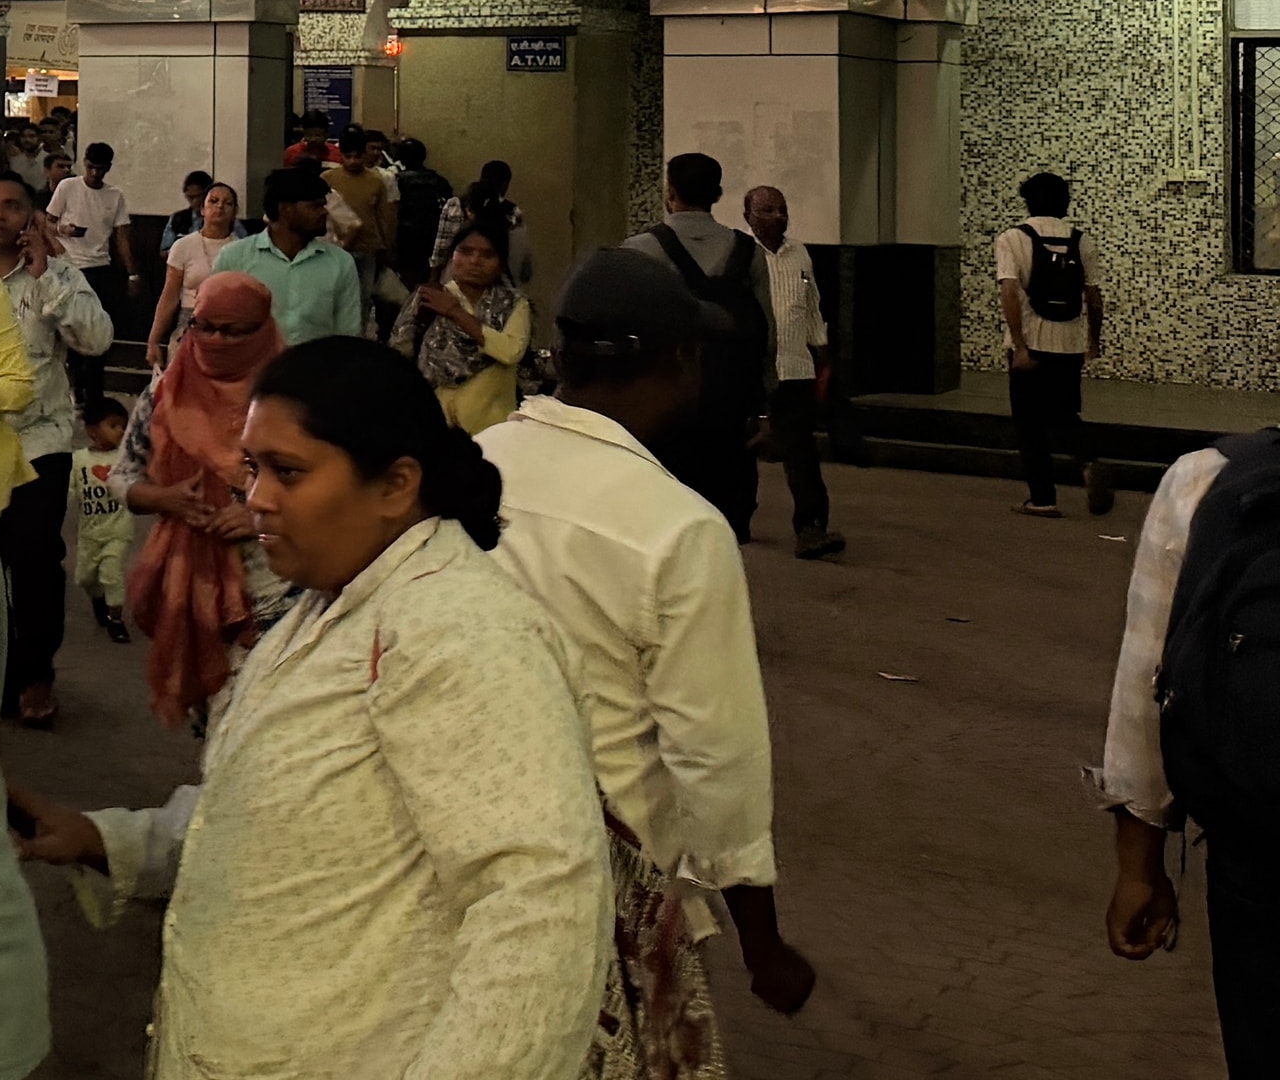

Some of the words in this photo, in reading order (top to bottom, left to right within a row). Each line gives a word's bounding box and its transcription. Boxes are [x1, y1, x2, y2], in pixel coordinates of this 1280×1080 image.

[510, 55, 561, 66] A.T.V.M
[81, 466, 88, 485] I
[82, 485, 111, 500] MO
[83, 500, 120, 516] DAD
